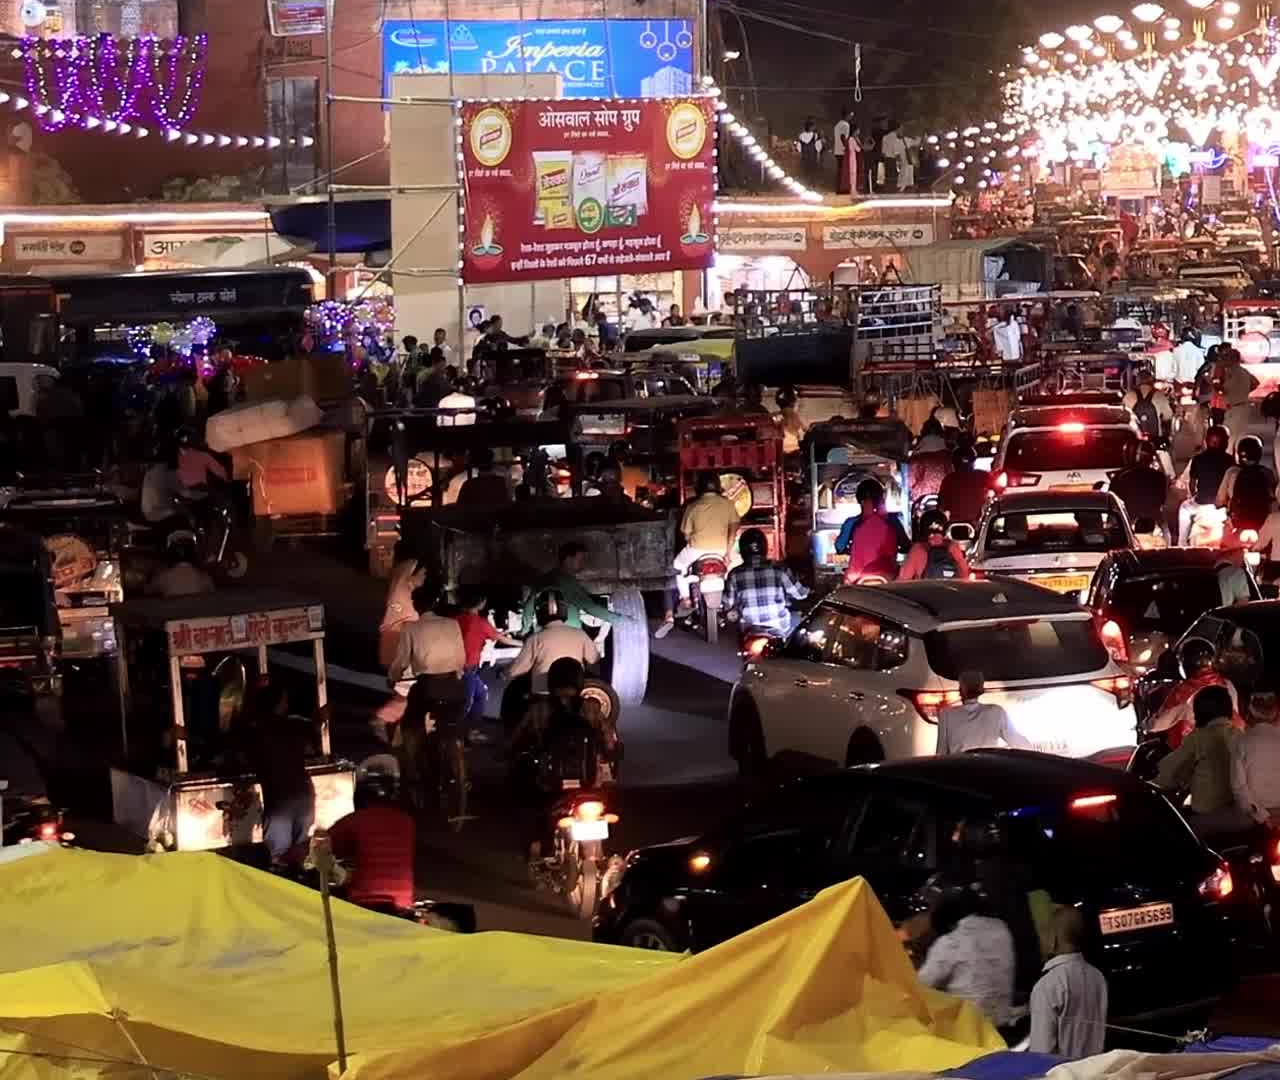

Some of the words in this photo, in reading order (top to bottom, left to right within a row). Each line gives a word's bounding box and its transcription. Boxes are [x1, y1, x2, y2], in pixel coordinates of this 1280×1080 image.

[537, 106, 591, 129] ओसवाल
[594, 105, 617, 126] सोप
[621, 109, 641, 132] ग्रुप
[585, 254, 597, 266] 67
